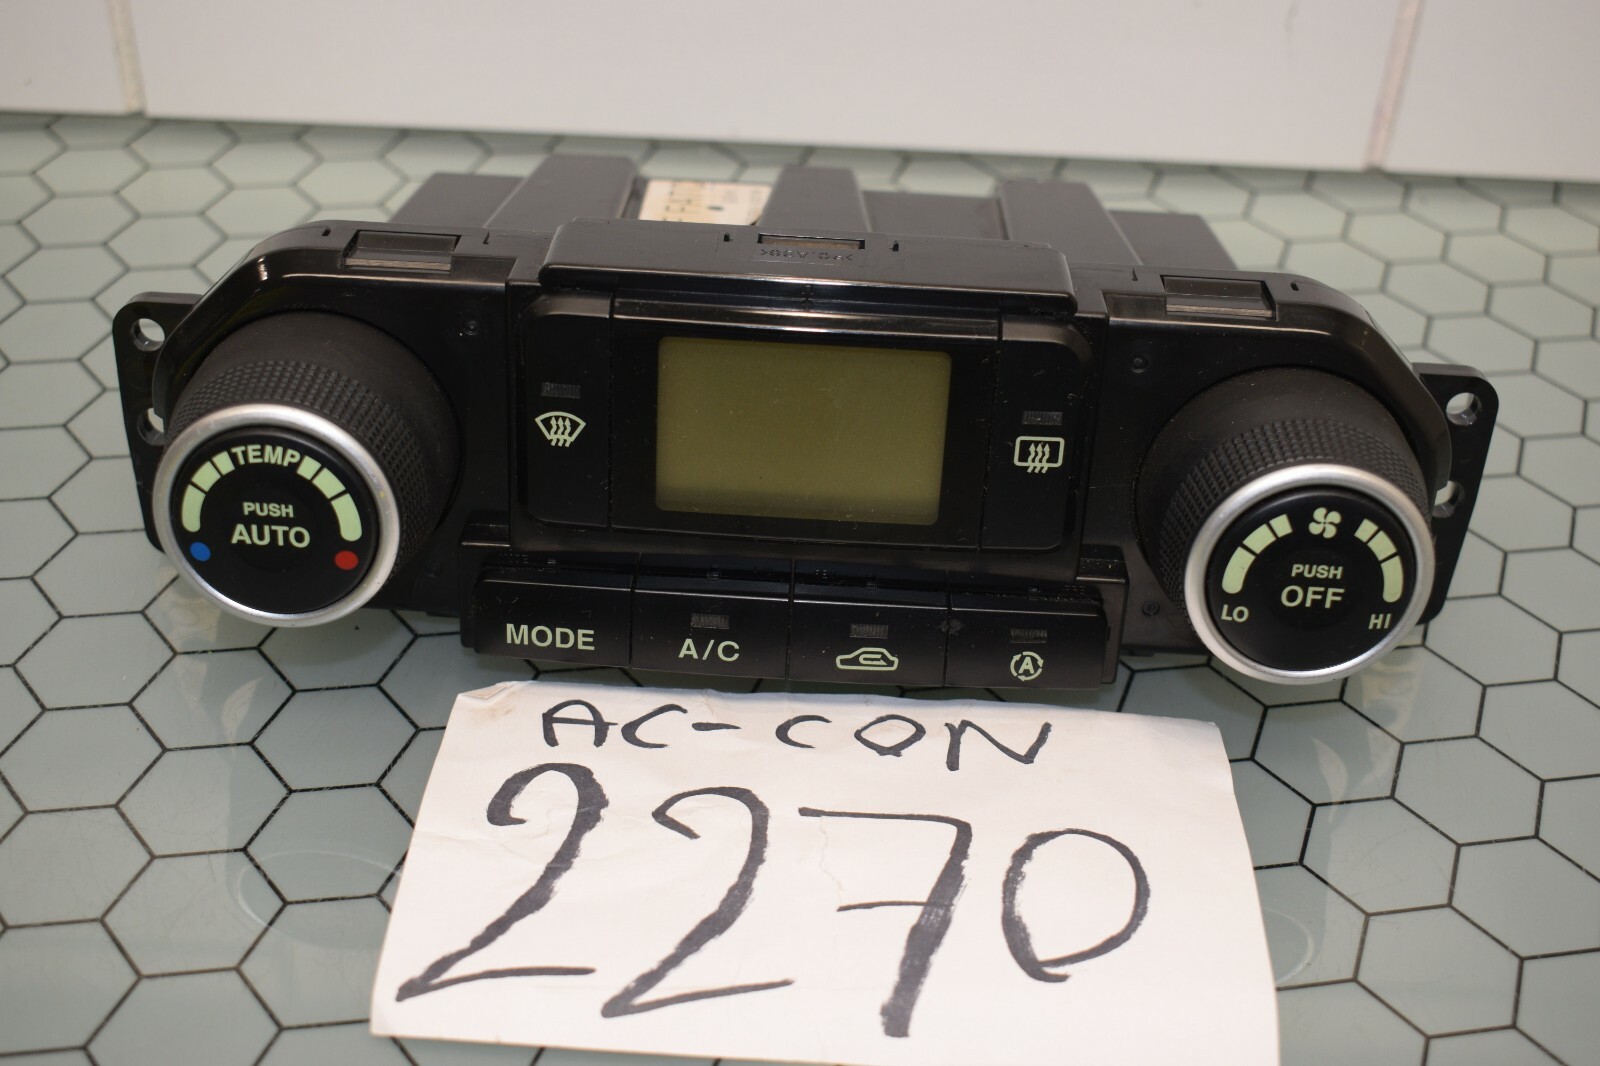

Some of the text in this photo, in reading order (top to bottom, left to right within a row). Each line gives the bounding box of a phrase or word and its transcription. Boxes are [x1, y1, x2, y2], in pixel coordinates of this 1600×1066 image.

[231, 445, 300, 467] TEMP
[243, 502, 294, 517] PUSH
[231, 523, 310, 548] AUTO
[1291, 563, 1343, 579] PUSH
[1281, 585, 1345, 608] OFF
[1221, 605, 1249, 622] LO
[1368, 613, 1392, 629] HI
[505, 623, 595, 651] MODE
[678, 638, 740, 662] A/C
[1018, 656, 1035, 674] A
[395, 762, 1150, 1038] 2270
